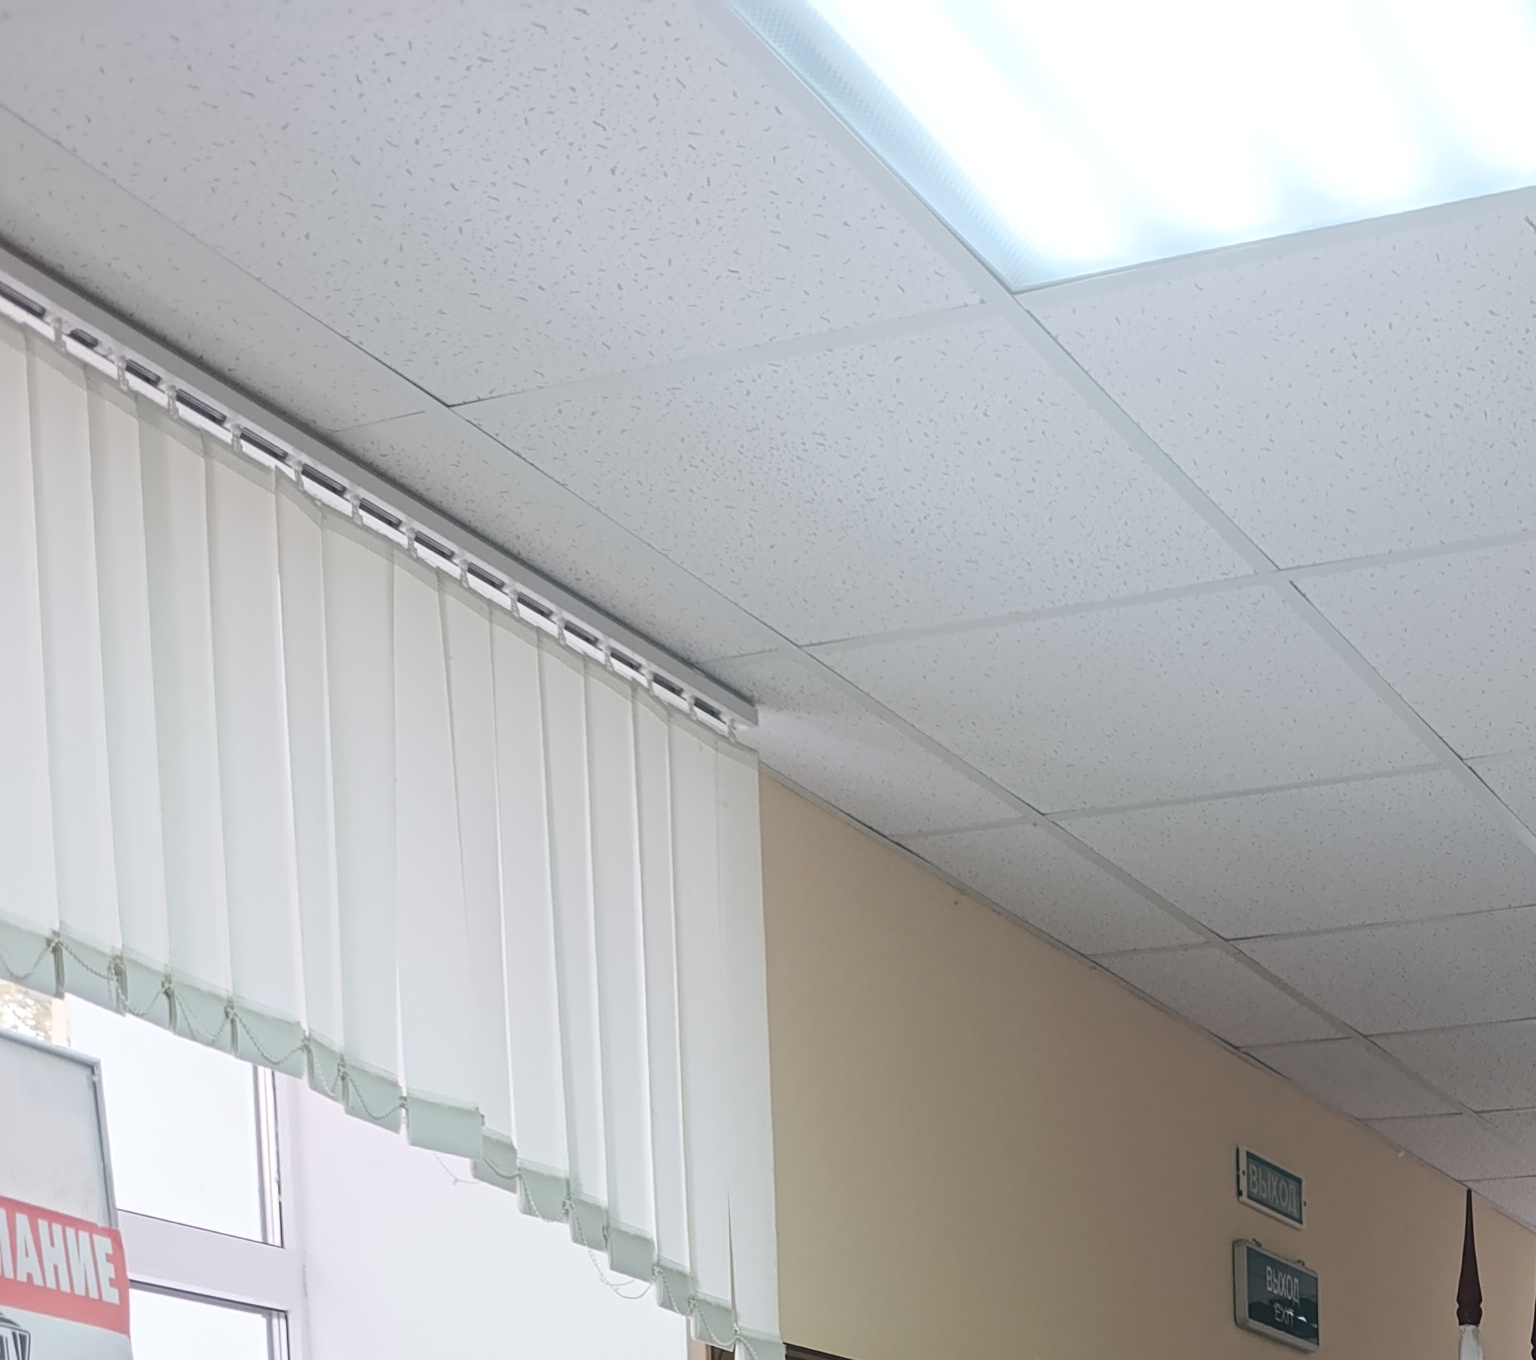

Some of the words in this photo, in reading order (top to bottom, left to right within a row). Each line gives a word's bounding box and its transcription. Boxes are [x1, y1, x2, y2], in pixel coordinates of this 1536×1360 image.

[1249, 1163, 1298, 1217] ВЫХОД
[1266, 1265, 1300, 1308] ВЫХОД
[1274, 1303, 1295, 1327] EXIT
